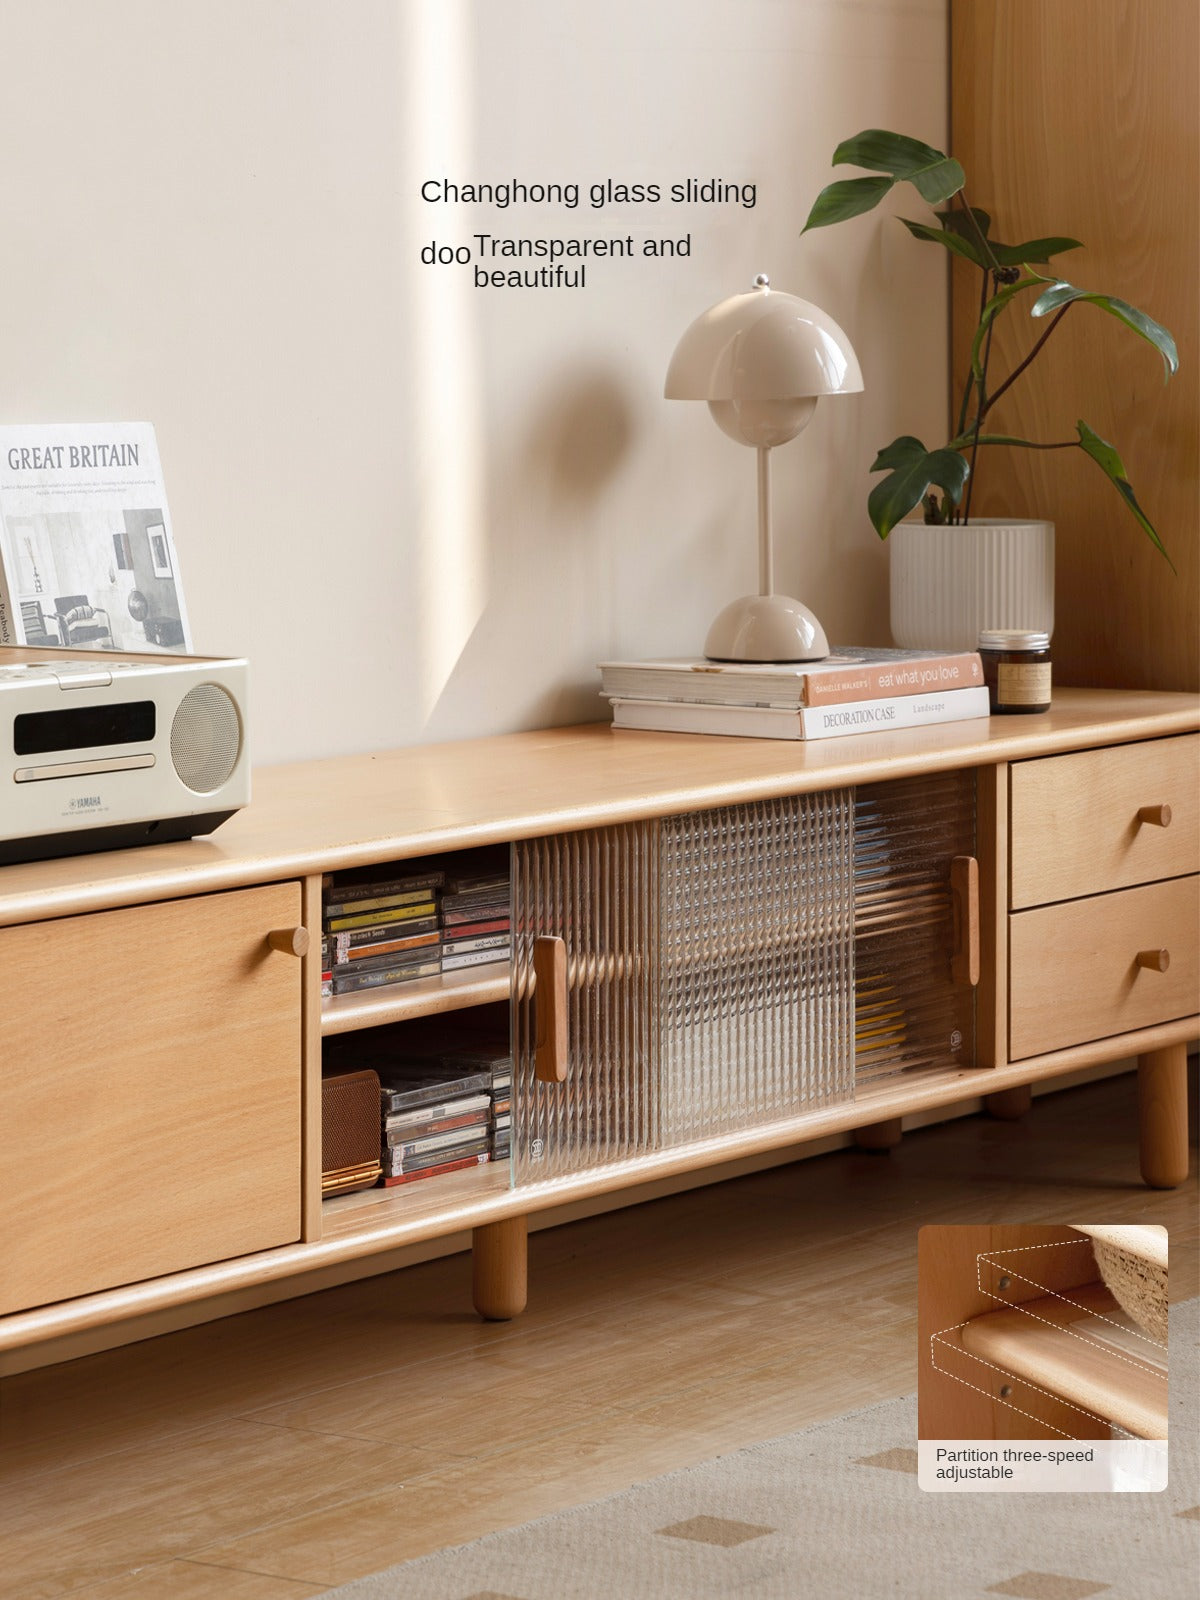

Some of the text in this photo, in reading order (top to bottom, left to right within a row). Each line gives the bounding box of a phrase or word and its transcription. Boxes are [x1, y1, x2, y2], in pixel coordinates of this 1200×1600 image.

[8, 444, 139, 470] GREAT BRITAIN
[878, 665, 960, 688] eat what you love
[823, 706, 896, 728] DECORATION CASE
[912, 702, 945, 714] Landscape
[76, 796, 101, 808] YAMAHA
